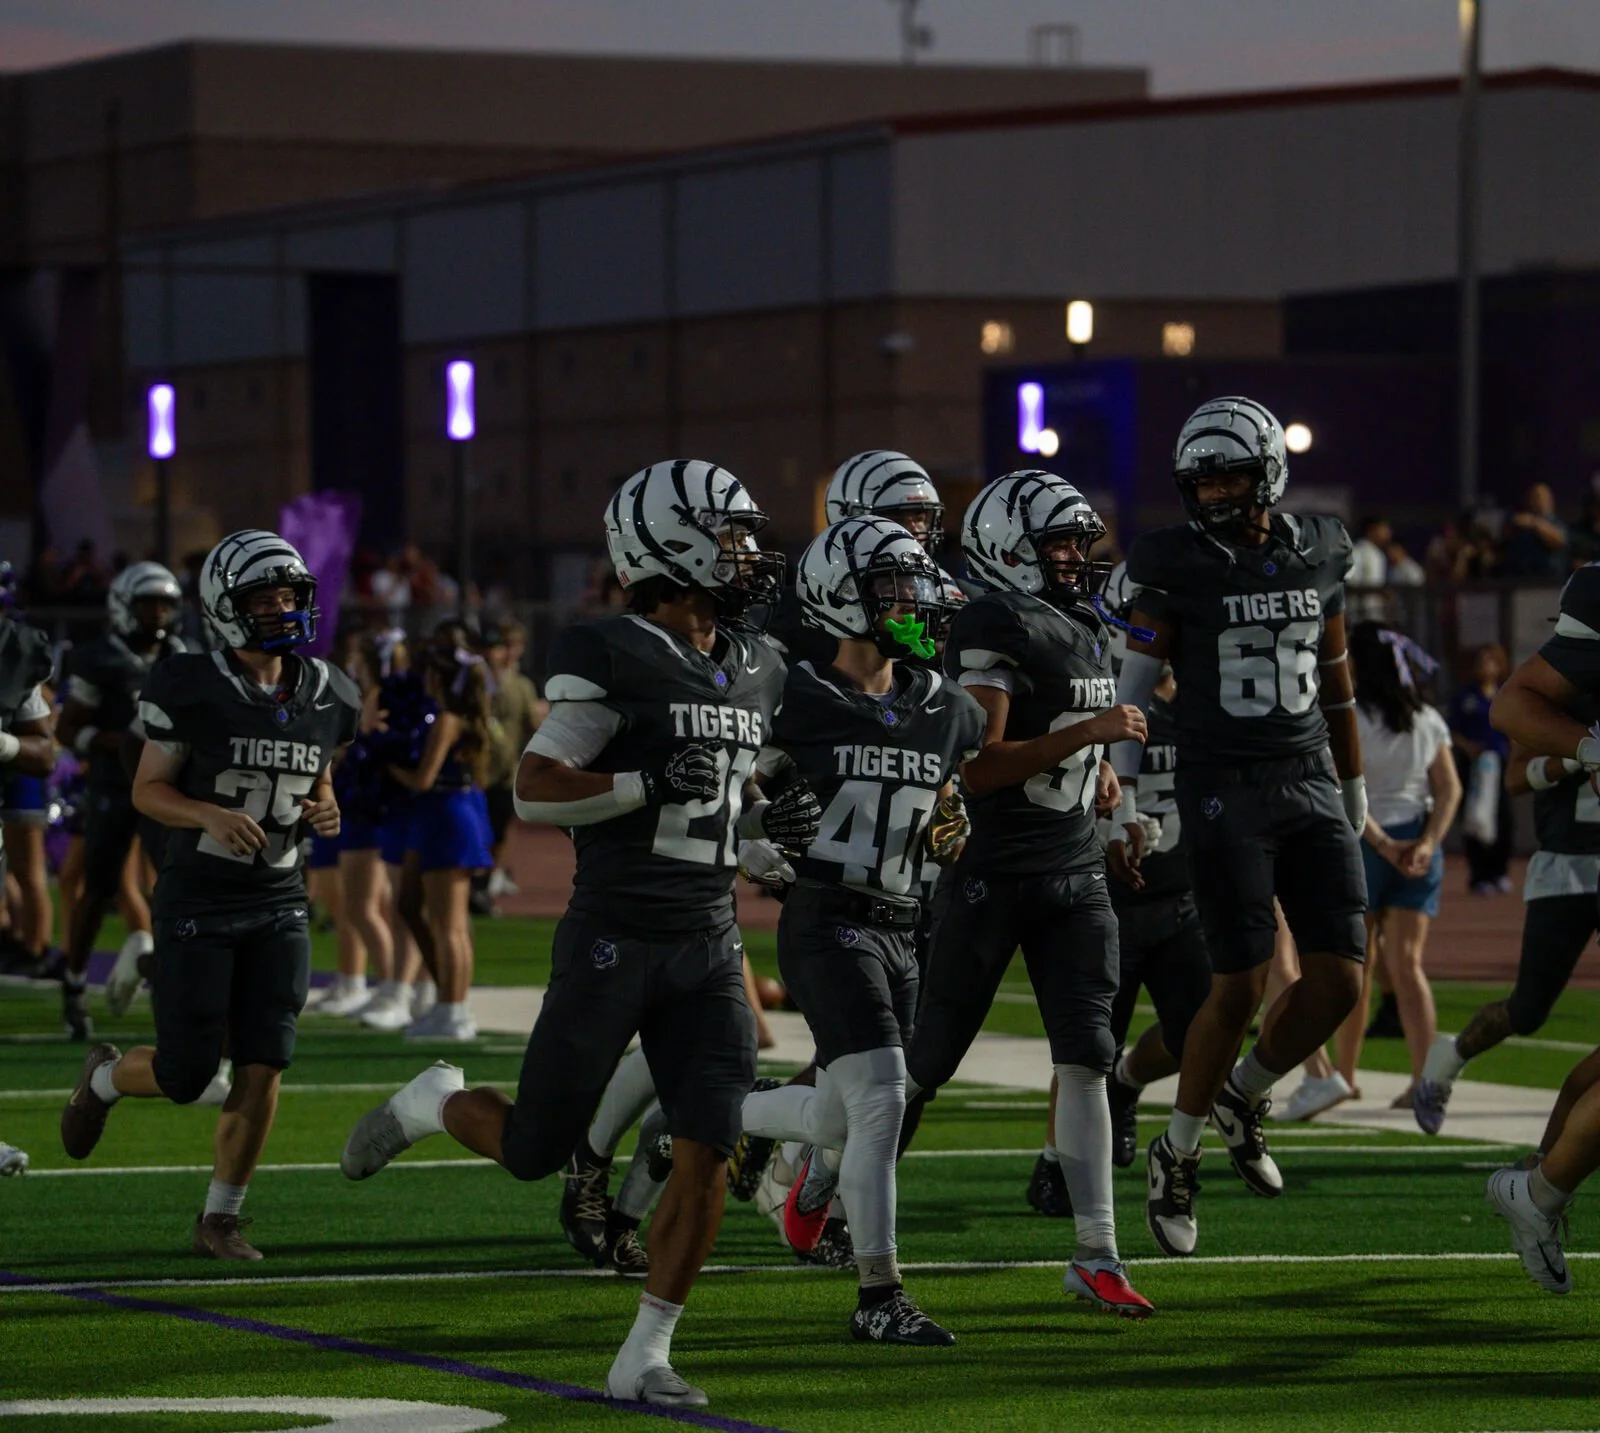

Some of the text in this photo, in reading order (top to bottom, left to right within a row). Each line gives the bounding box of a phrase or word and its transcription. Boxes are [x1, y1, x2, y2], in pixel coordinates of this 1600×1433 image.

[1222, 588, 1320, 623] TIGERS
[1217, 620, 1320, 717] 66
[669, 703, 763, 745] TIGERS
[229, 736, 321, 774] TIGERS
[832, 745, 942, 785] TIGERS
[651, 747, 758, 867] 21
[806, 779, 937, 895] 40
